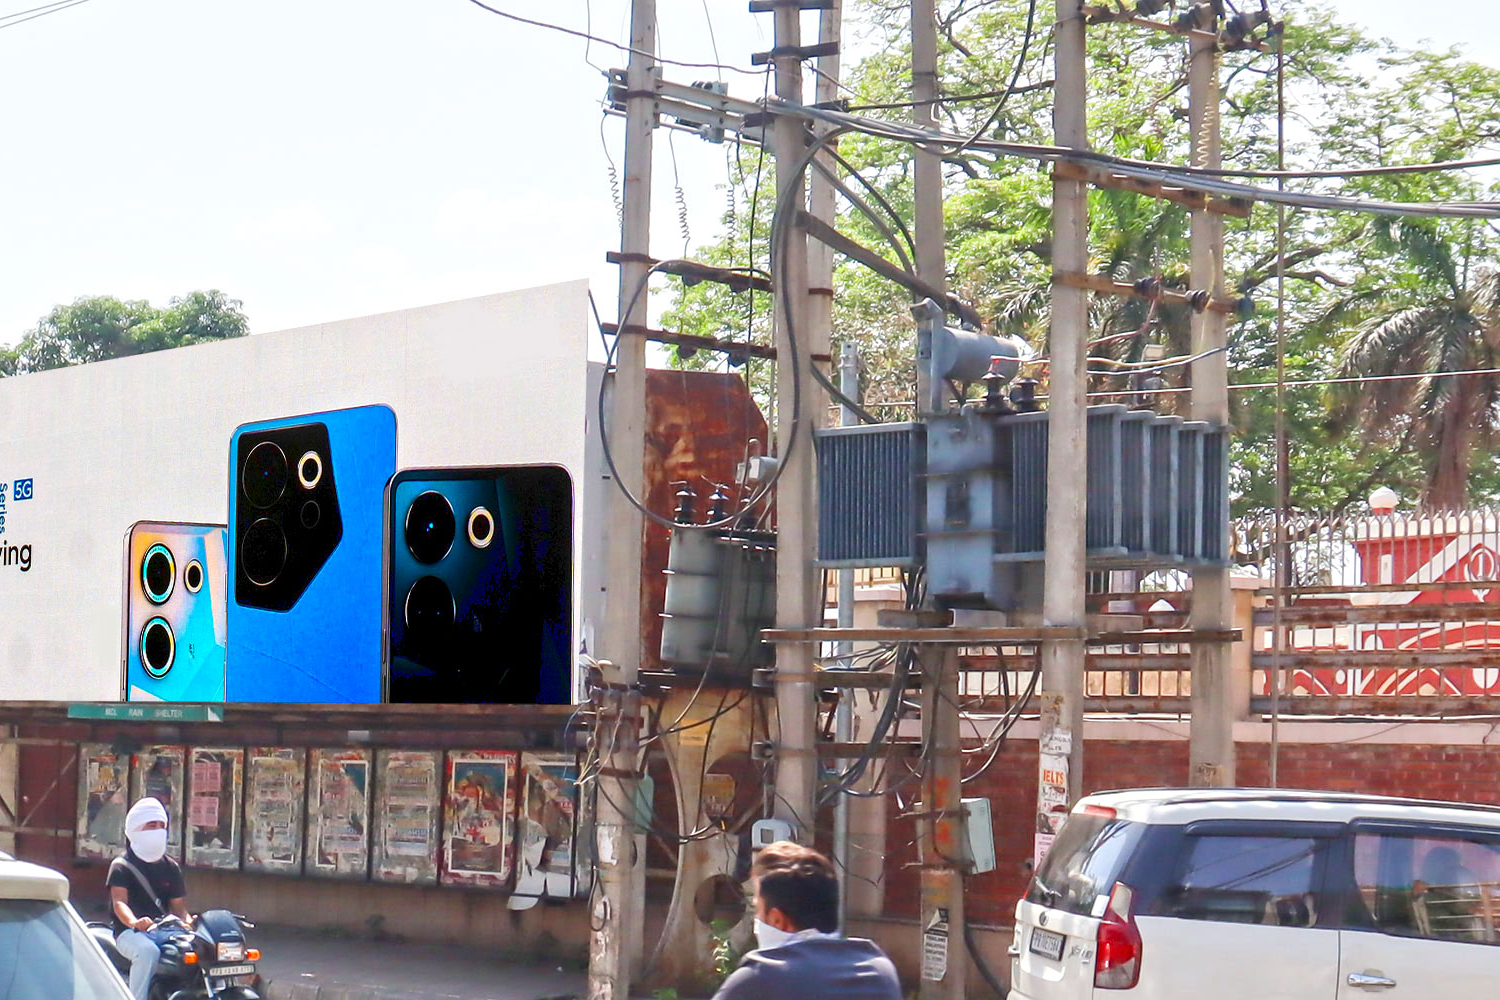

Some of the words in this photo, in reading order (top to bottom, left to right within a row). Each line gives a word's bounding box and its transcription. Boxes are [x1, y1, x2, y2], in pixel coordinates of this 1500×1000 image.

[14, 479, 33, 500] 5G
[128, 708, 144, 717] RAIN
[155, 709, 183, 718] SHELTER
[1043, 769, 1065, 785] IELTS
